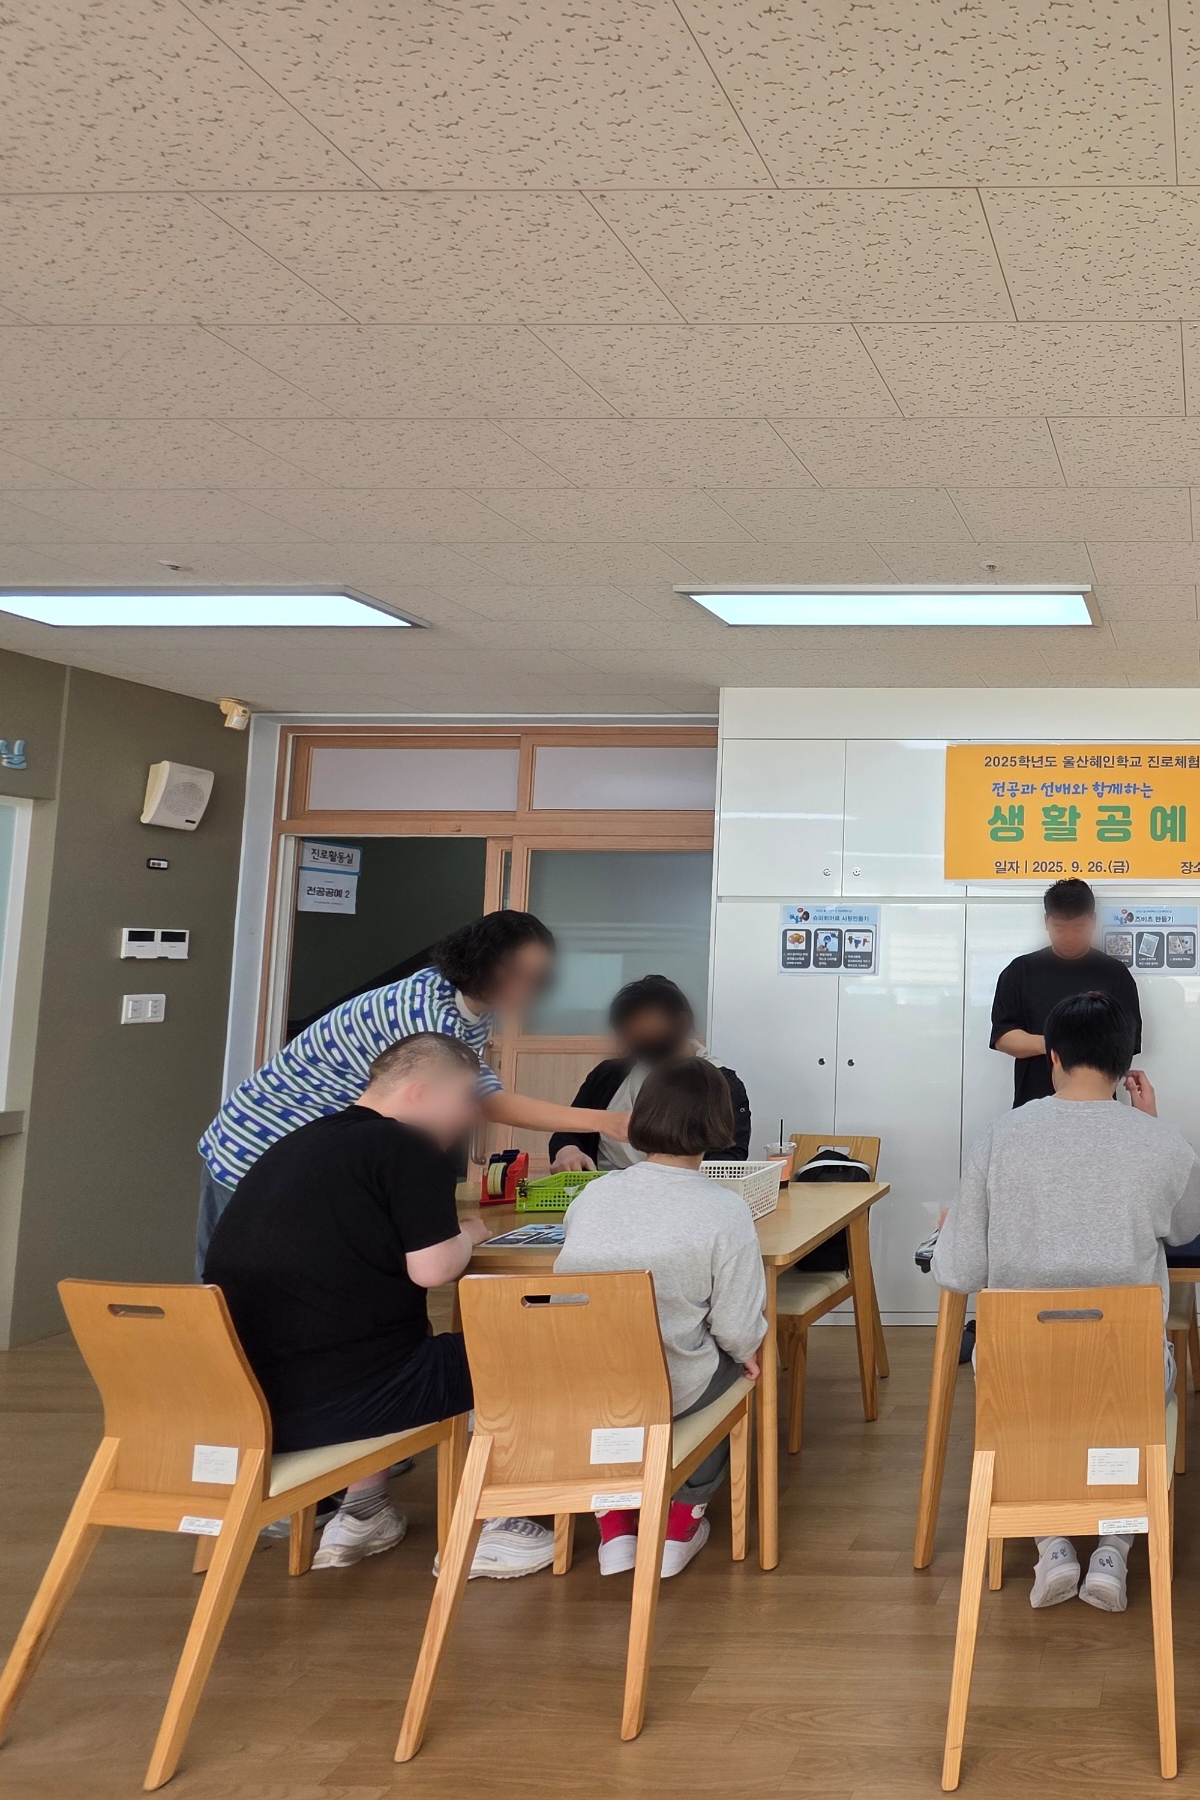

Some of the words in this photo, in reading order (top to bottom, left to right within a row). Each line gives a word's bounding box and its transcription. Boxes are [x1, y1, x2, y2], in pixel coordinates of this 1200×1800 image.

[984, 755, 1057, 769] 2025학년도
[1062, 755, 1142, 769] 울산혜인학교
[991, 781, 1037, 798] 전공과
[1040, 781, 1088, 798] 선배와
[1092, 781, 1154, 799] 함께하는
[987, 804, 1187, 843] 생활공예
[311, 848, 353, 864] 진로활동실
[994, 860, 1020, 874] 일자
[1032, 861, 1067, 873] 2025.
[1071, 861, 1083, 873] 9.
[1087, 860, 1130, 874] 26.(금)
[307, 886, 343, 898] 전공공예
[344, 889, 350, 898] 2
[1155, 915, 1174, 923] 만들기
